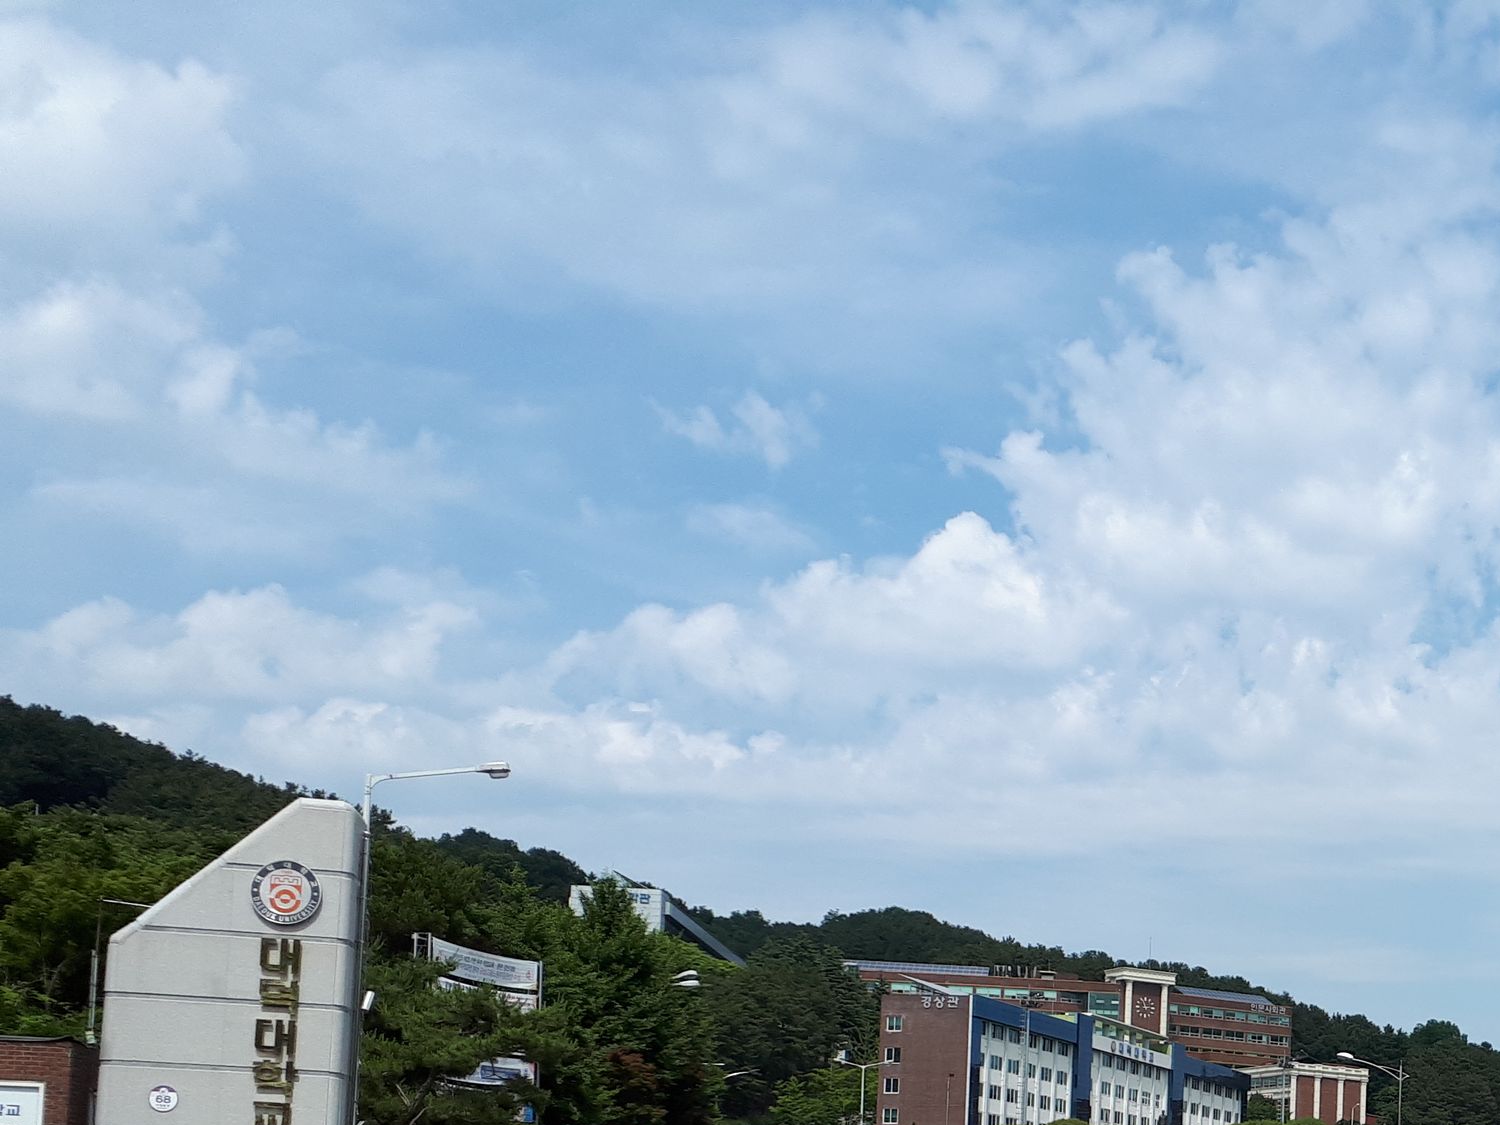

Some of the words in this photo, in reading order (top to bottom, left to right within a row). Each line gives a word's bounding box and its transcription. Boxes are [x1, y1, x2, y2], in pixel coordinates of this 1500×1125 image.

[278, 899, 318, 922] UNIVERSITY
[920, 996, 960, 1009] 경상관
[155, 1095, 172, 1104] 68
